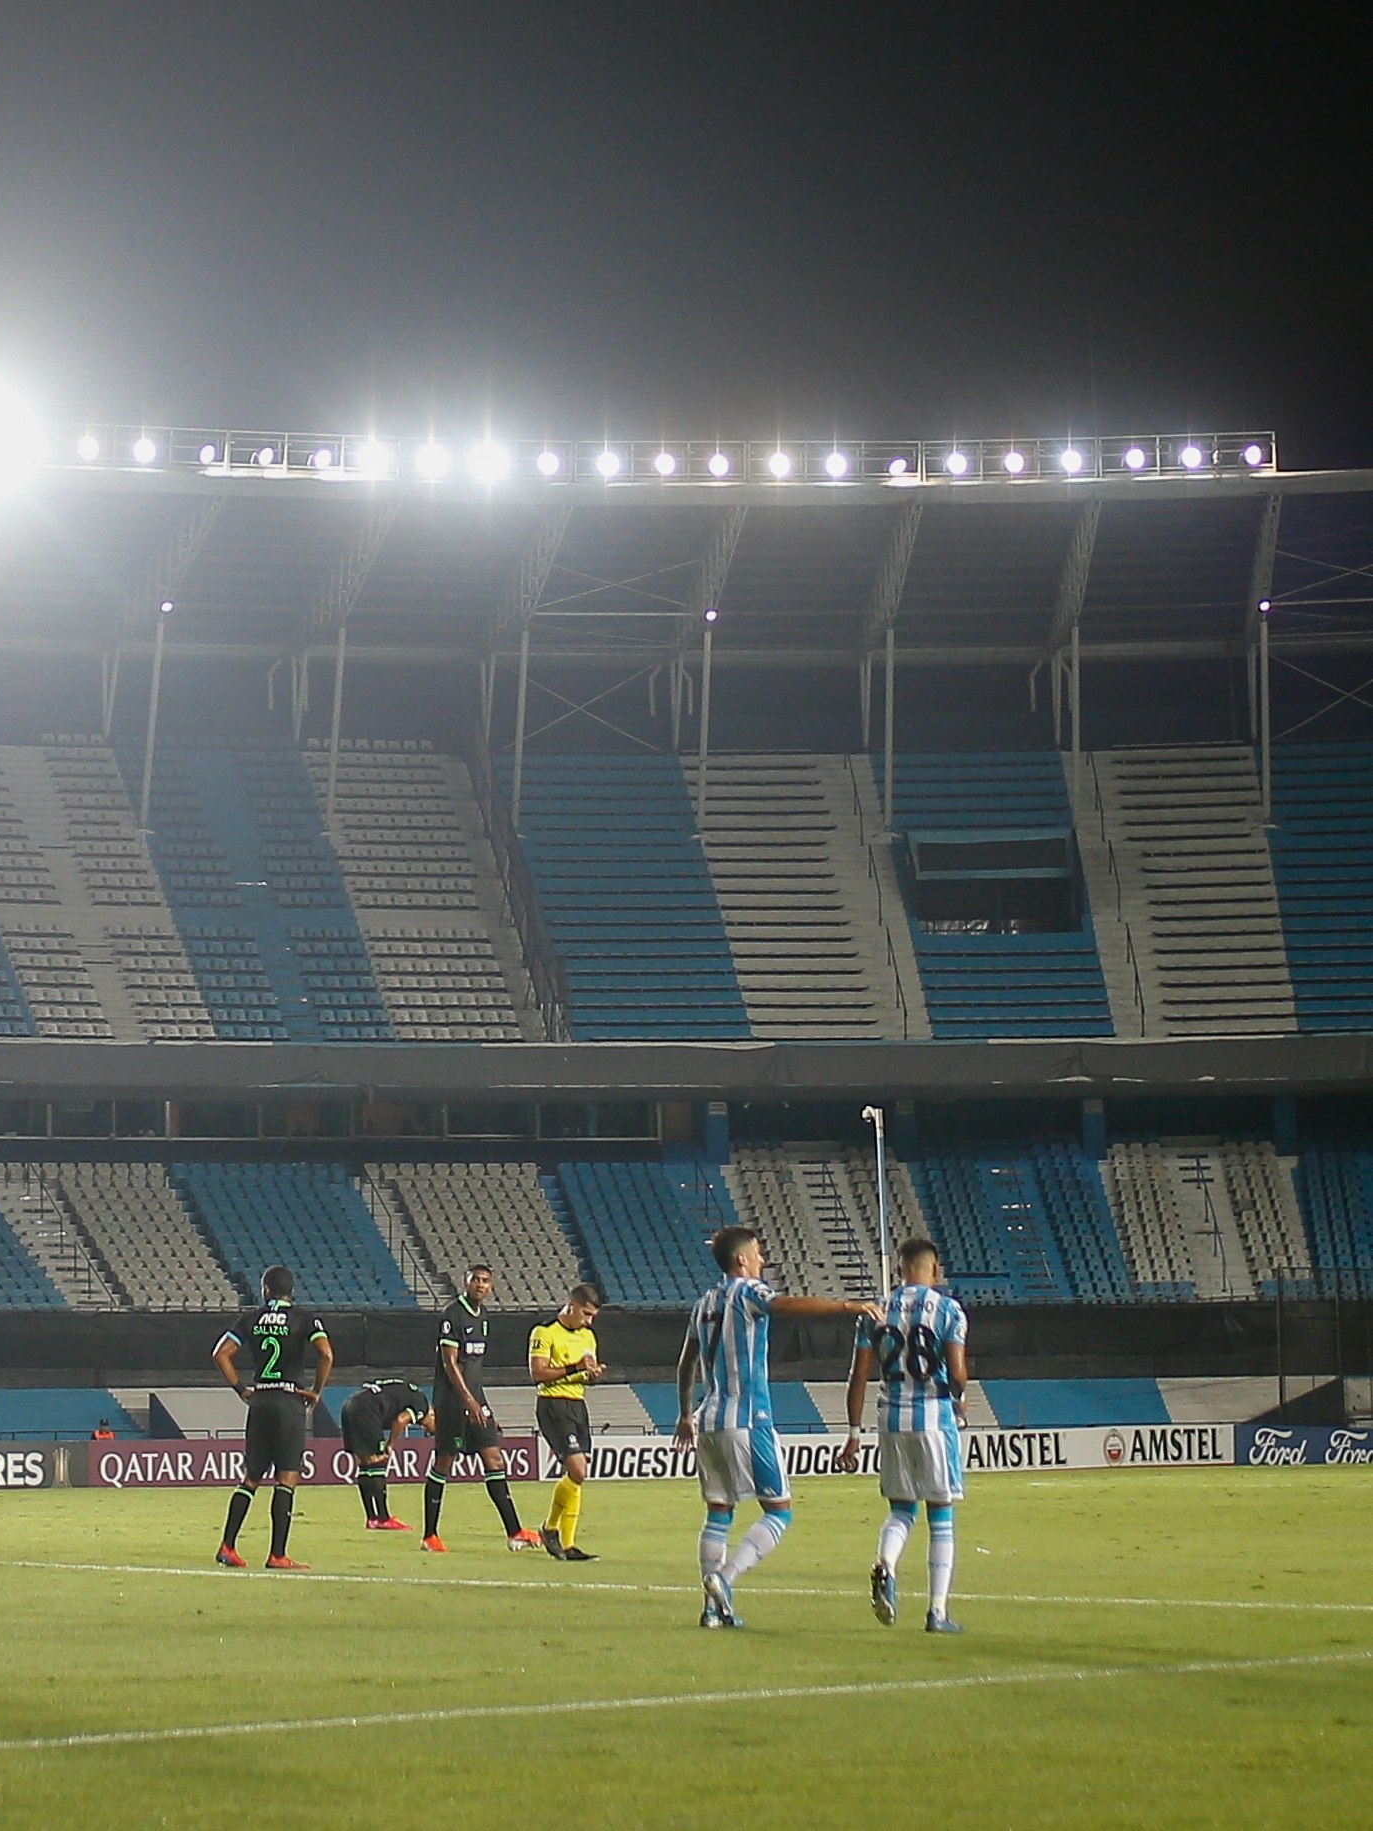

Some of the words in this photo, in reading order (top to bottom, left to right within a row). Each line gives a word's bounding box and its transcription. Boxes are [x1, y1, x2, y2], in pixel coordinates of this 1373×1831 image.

[253, 1325, 289, 1337] SALAZAR
[260, 1336, 282, 1380] 2
[872, 1324, 939, 1381] 28
[966, 1432, 1067, 1469] AMSTEL
[1129, 1428, 1222, 1463] AMSTEL
[1248, 1427, 1307, 1466] Ford
[99, 1452, 194, 1488] QATAR
[201, 1450, 315, 1482] AIRS
[332, 1451, 420, 1484] QAR
